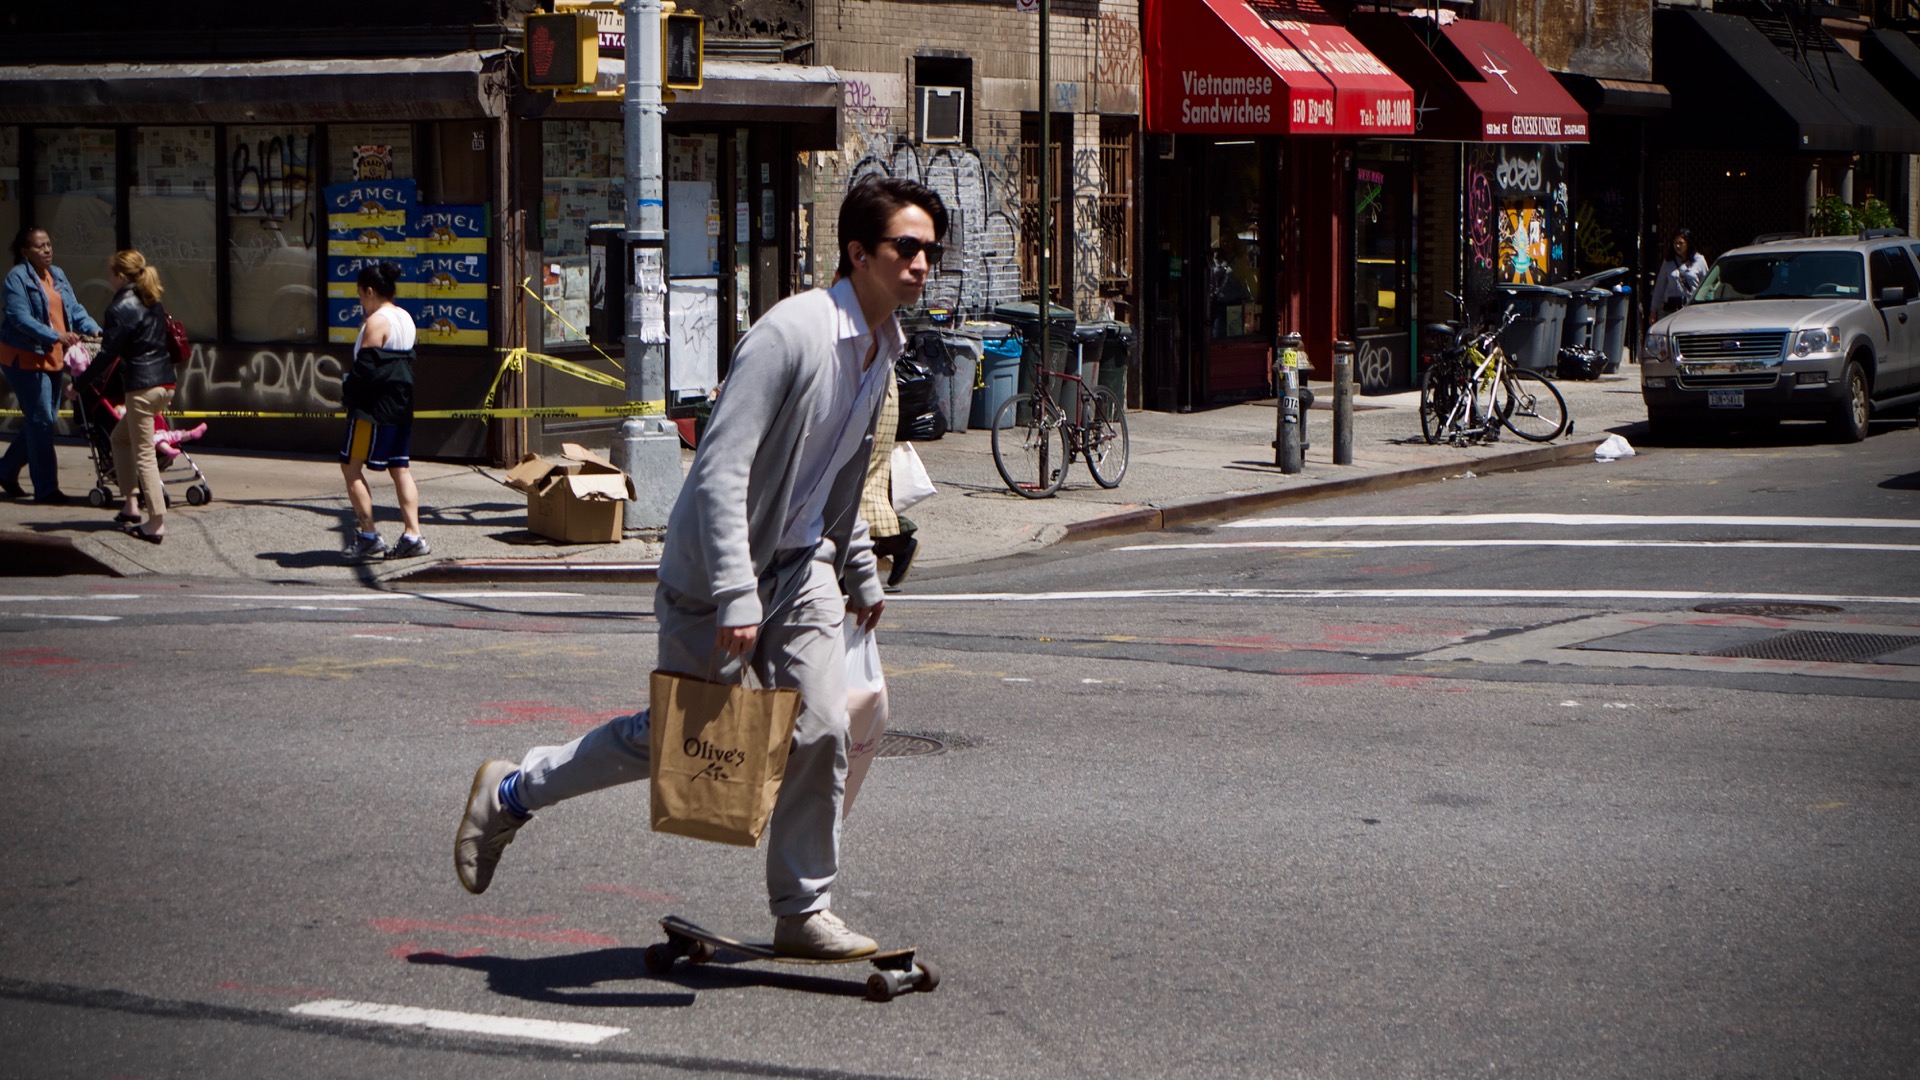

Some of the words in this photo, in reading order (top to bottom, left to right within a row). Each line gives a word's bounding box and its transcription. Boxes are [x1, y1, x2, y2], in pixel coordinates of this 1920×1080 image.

[1308, 40, 1392, 75] Sandwiches
[1182, 71, 1273, 96] Vietnamese
[1181, 97, 1271, 125] Sandwiches
[1293, 99, 1306, 124] 150
[1359, 109, 1375, 127] Tel:
[1511, 115, 1538, 136] GENESIS
[1538, 116, 1562, 136] UNISEX
[336, 186, 407, 208] CAMEL
[683, 737, 745, 768] Olive's
